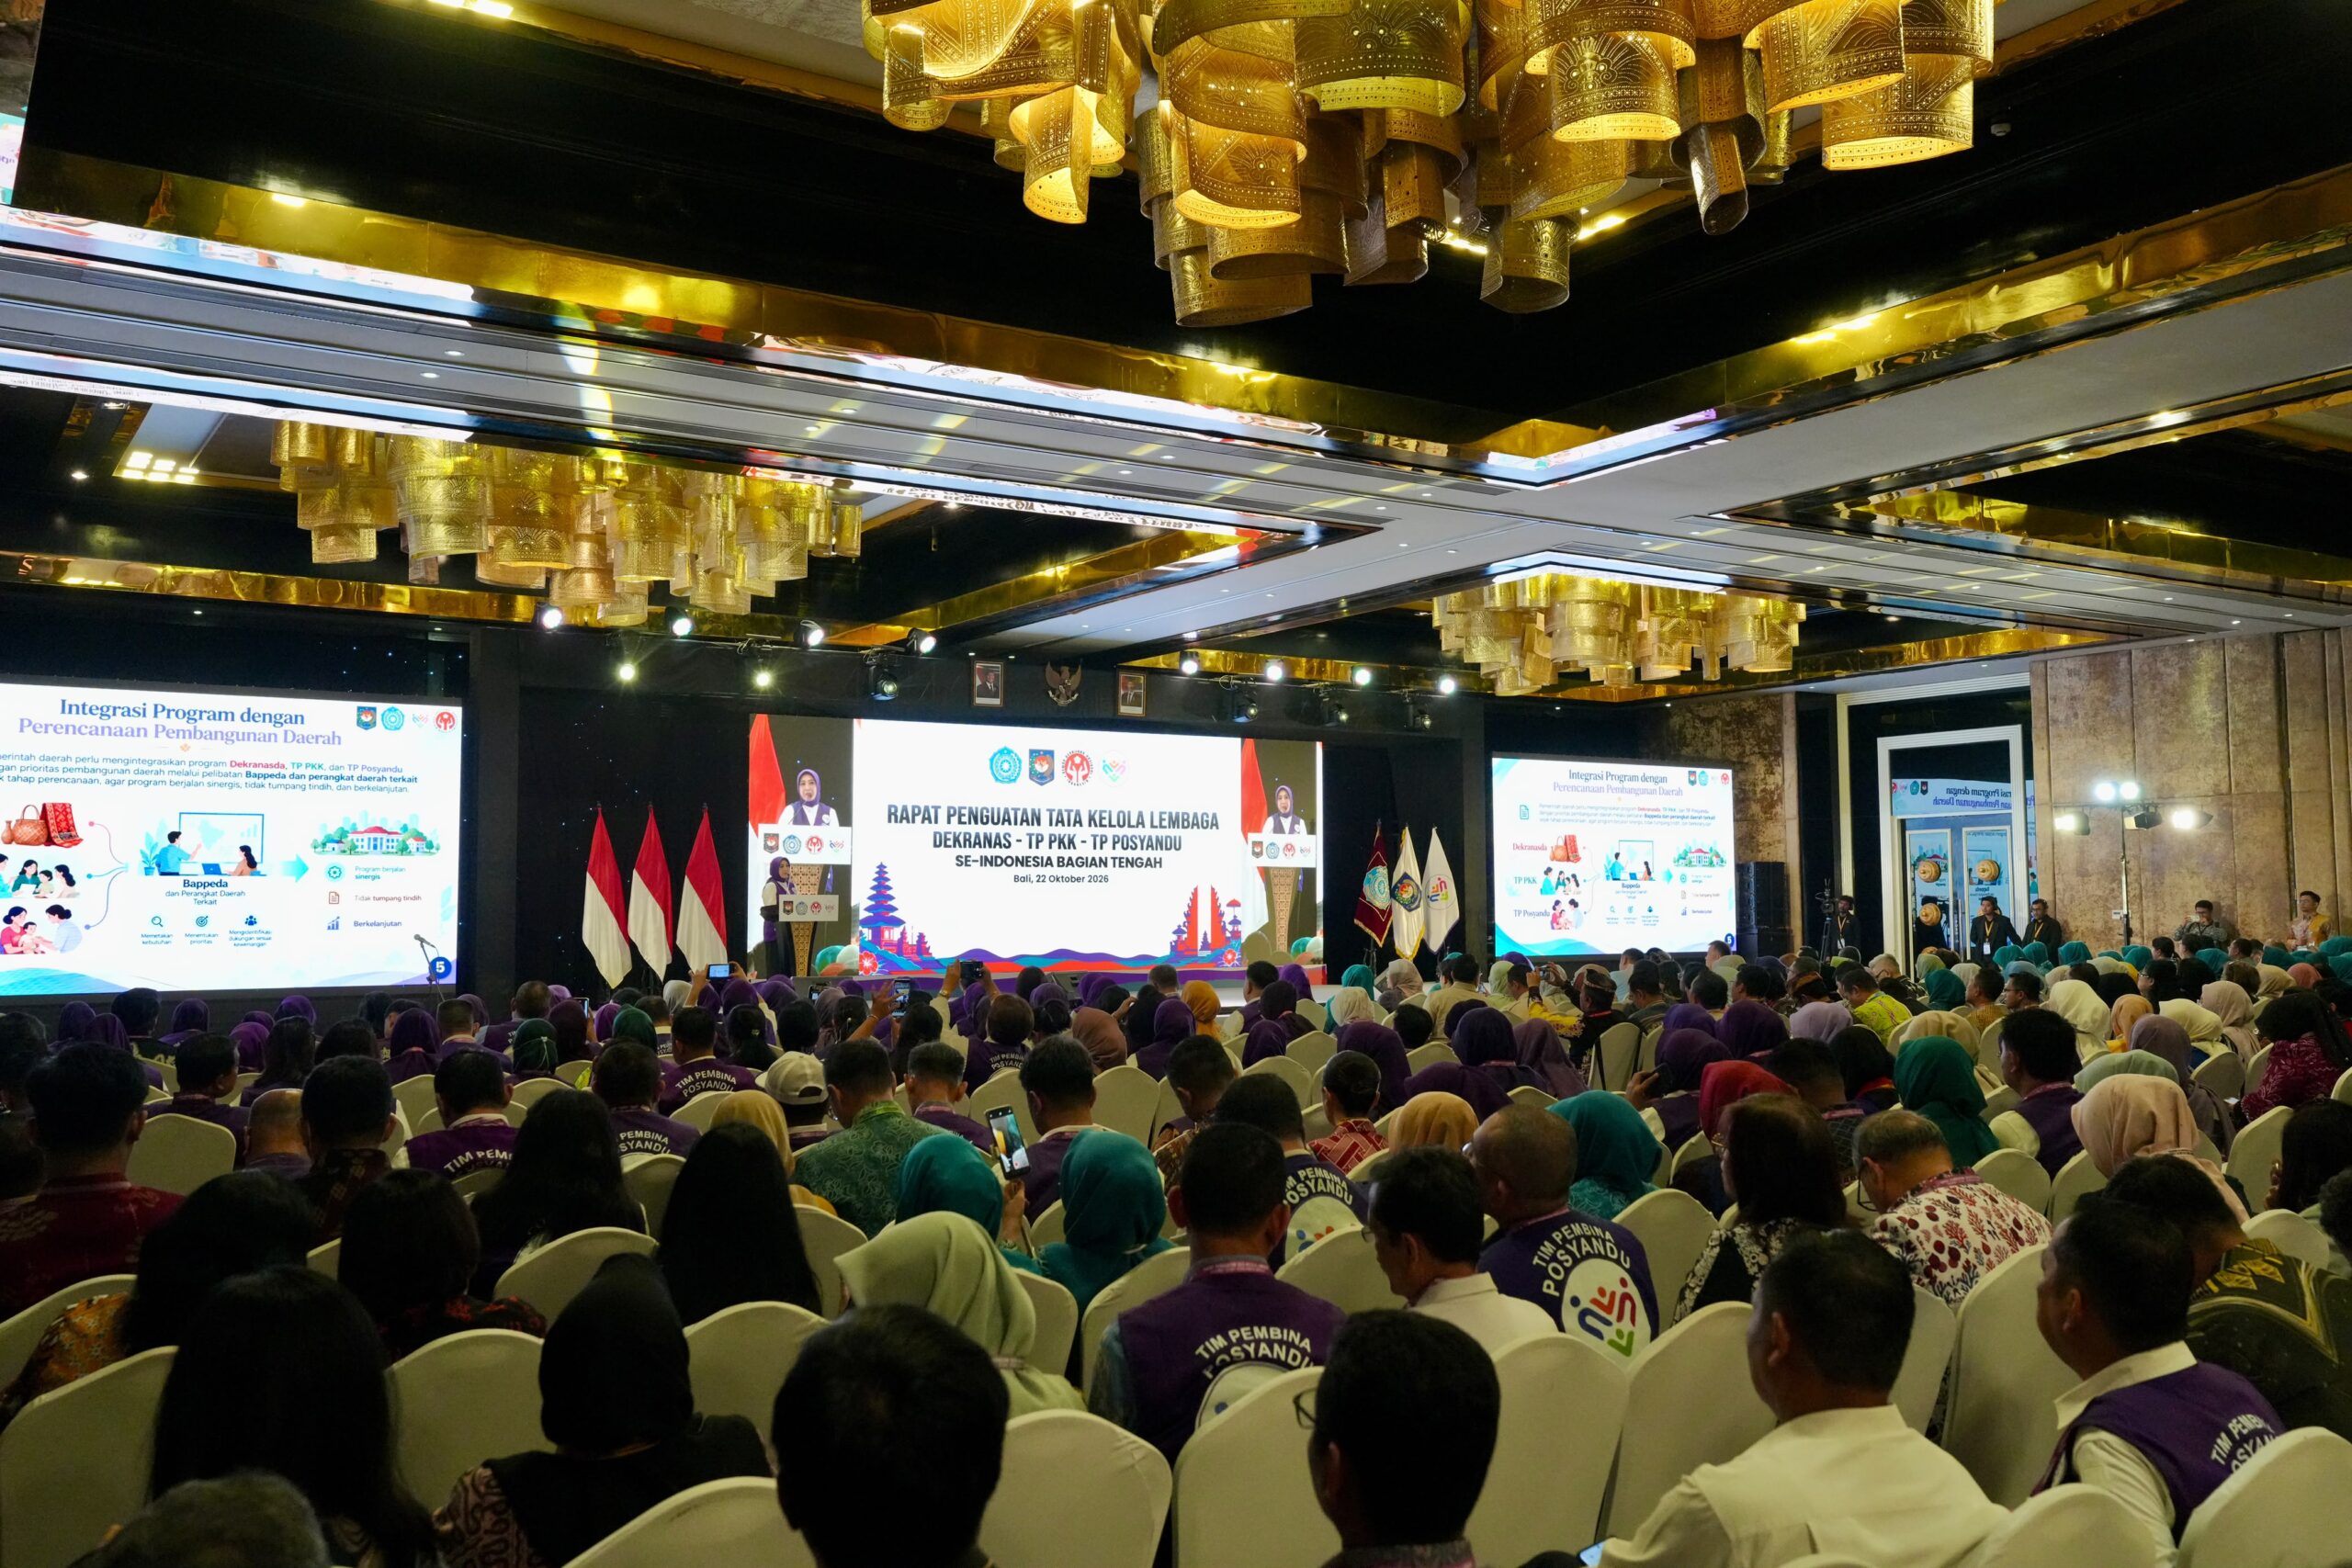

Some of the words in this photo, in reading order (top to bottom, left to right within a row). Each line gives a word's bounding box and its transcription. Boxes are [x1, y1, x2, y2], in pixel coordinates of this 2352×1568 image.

[60, 699, 147, 720] Integrasi
[153, 703, 235, 725] Program
[240, 707, 305, 728] dengan
[18, 717, 148, 739] Perencanaan
[154, 724, 278, 745] Pembangunan
[283, 729, 342, 746] Daerah
[20, 764, 60, 773] prioritas
[62, 766, 130, 776] pembangunan
[168, 769, 199, 777] melalui
[202, 770, 243, 779] pelibatan
[245, 771, 287, 781] Bappeda
[289, 772, 306, 780] dan
[309, 773, 354, 783] perangkat
[356, 774, 387, 783] daerah
[390, 775, 417, 784] terkait
[75, 756, 99, 764] perlu
[102, 756, 187, 768] mengintegrasikan
[188, 760, 227, 769] program
[291, 761, 302, 770] TP
[329, 763, 345, 772] dan
[361, 764, 402, 774] Posyandu
[7, 775, 35, 784] tahap
[105, 778, 125, 786] agar
[128, 779, 166, 788] program
[169, 779, 204, 788] berjalan
[268, 783, 306, 792] tumpang
[1568, 770, 1603, 782] Integrasi
[1605, 772, 1639, 784] Program
[1640, 773, 1668, 785] dengan
[1553, 782, 1604, 793] Perencanaan
[1607, 784, 1657, 796] Pembangunan
[1658, 785, 1683, 796] Daerah
[888, 804, 941, 825] RAPAT
[946, 806, 1041, 827] PENGUATAN
[1046, 808, 1083, 828] TATA
[1088, 809, 1146, 829] KELOLA
[1149, 811, 1219, 829] LEMBAGA
[933, 831, 1012, 849] DEKRANAS
[1026, 833, 1044, 850] TP
[1048, 833, 1077, 850] PKK
[1091, 834, 1108, 851] TP
[1112, 834, 1182, 852] POSYANDU
[1512, 842, 1547, 852] Dekranasda
[956, 855, 1054, 868] SE-INDONESIA
[1057, 856, 1108, 868] BAGIAN
[1111, 857, 1162, 869] TENGAH
[183, 879, 228, 889] Bappeda
[1014, 874, 1034, 884] Bali,
[1035, 874, 1046, 883] 22
[1048, 874, 1085, 883] Oktober
[1087, 874, 1109, 883] 2026
[1514, 876, 1522, 885] TP
[1523, 876, 1537, 885] PKK
[181, 890, 218, 898] Perangkat
[1513, 909, 1522, 918] TP
[1523, 909, 1550, 919] Posyandu
[354, 920, 401, 929] Berkelanjutan
[435, 961, 446, 974] 5
[675, 1074, 695, 1089] TIM
[695, 1069, 737, 1085] PEMBINA
[682, 1080, 734, 1098] POSYANDU
[619, 1130, 669, 1145] PEMBINA
[444, 1151, 474, 1173] TIM
[1296, 1167, 1348, 1191] PEMBINA
[1283, 1178, 1353, 1205] OSYANDU
[1532, 1240, 1556, 1268] TIM
[1552, 1222, 1615, 1246] PEMBINA
[1542, 1236, 1631, 1297] POSYANDU
[1194, 1334, 1228, 1359] TIM
[1227, 1325, 1312, 1353] PEMBINA
[2211, 1431, 2233, 1466] TIM
